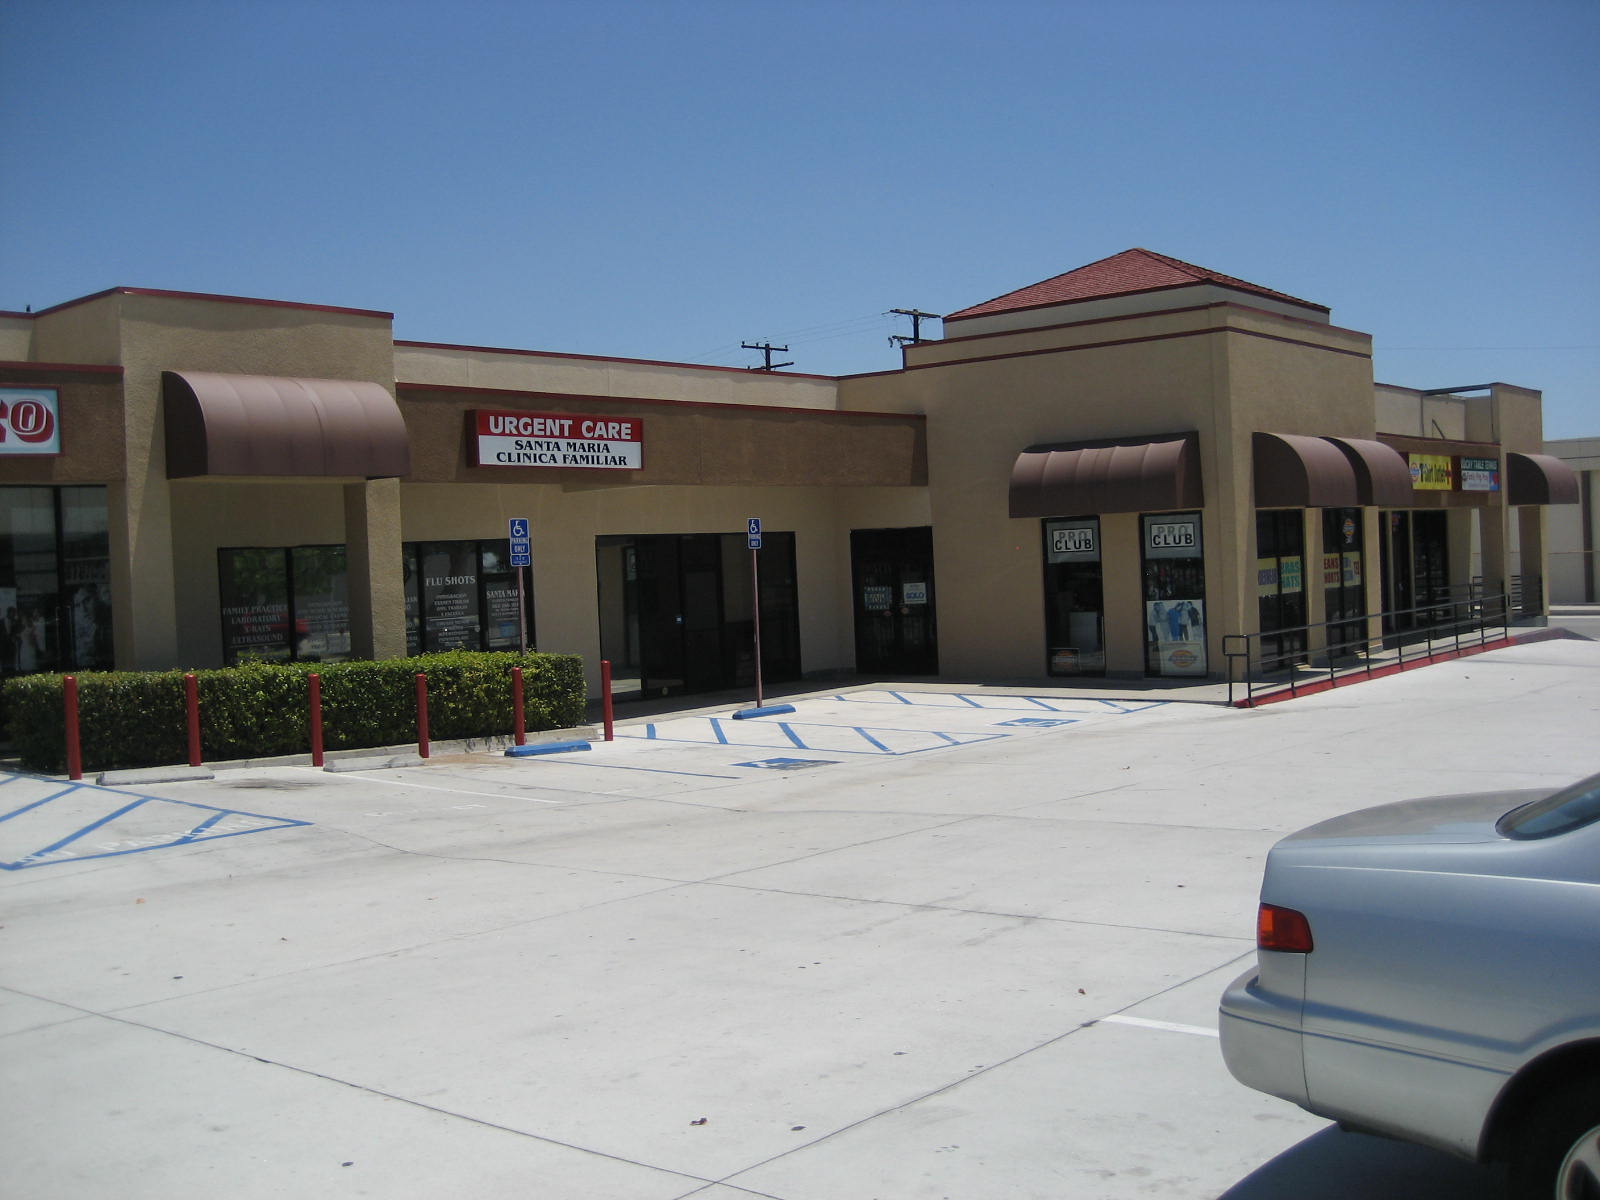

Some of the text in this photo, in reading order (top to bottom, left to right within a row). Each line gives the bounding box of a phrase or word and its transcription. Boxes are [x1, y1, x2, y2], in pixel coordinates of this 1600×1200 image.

[489, 415, 632, 440] URGENT CARE
[514, 439, 611, 454] SANTA MARIA
[496, 451, 628, 466] CLINICA FAMILIAR
[1059, 530, 1087, 542] PRO
[1158, 525, 1188, 537] PRO
[1055, 538, 1092, 551] CLUB
[1153, 533, 1193, 546] CLUB
[425, 575, 476, 587] FLU SHOTS
[486, 589, 506, 600] SANTA
[223, 606, 249, 616] FAMILY
[231, 614, 281, 625] LABORATORY
[232, 632, 283, 644] ULTRASOUND
